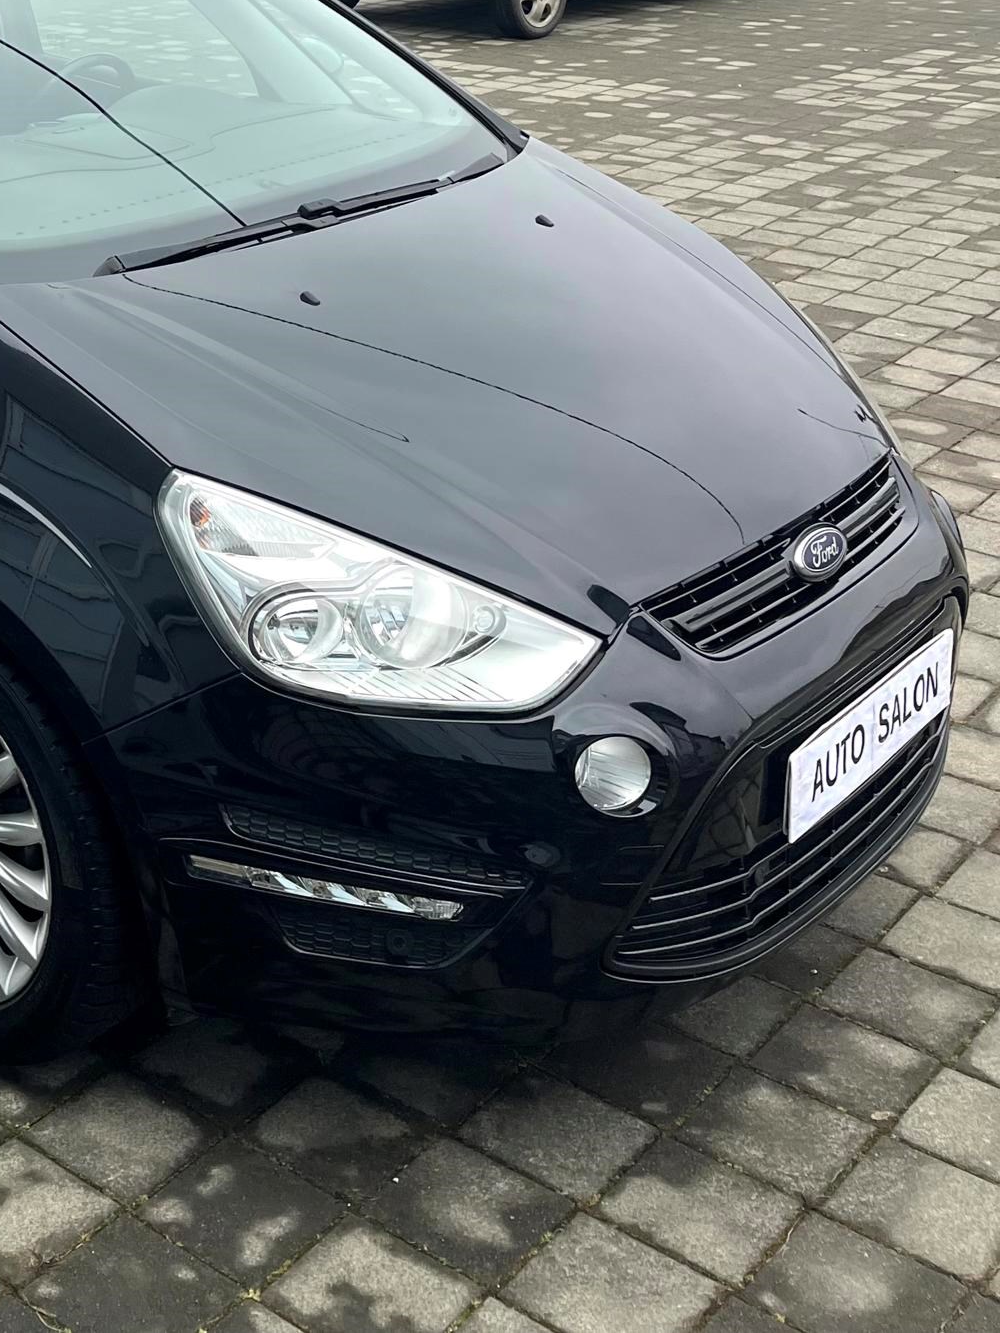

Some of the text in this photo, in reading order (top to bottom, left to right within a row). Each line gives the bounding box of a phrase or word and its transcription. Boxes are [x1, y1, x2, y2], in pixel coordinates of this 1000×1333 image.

[810, 538, 840, 569] Ford
[811, 661, 940, 802] AUTO SALON
